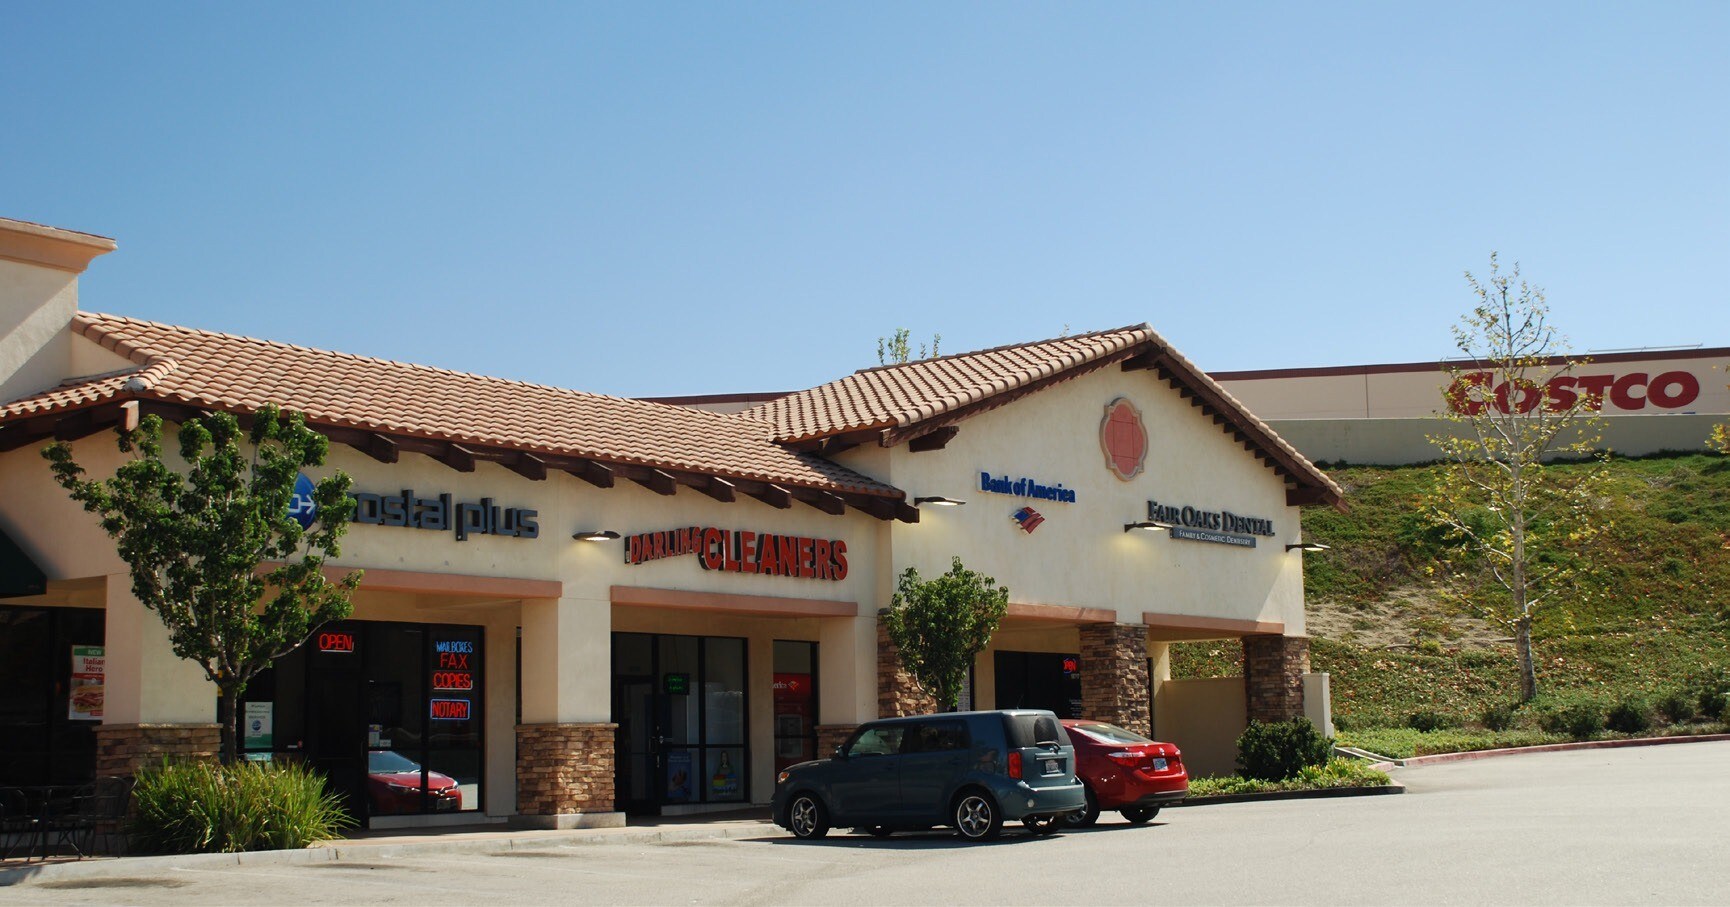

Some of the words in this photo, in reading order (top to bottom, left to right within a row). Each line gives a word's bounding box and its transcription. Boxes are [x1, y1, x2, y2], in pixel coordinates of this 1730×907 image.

[1447, 371, 1700, 415] COSTCO
[979, 472, 1012, 494] Bank
[1013, 478, 1026, 496] of
[1027, 479, 1075, 502] America
[343, 489, 452, 531] ostal
[456, 497, 540, 541] plus
[625, 526, 701, 565] DARLING
[698, 527, 848, 580] CLEANERS
[319, 633, 353, 651] OPEN
[436, 641, 473, 653] MAILBOXES
[85, 665, 103, 673] Hero
[440, 653, 468, 669] FAX
[433, 672, 471, 688] COPIES
[432, 701, 467, 718] NOTARY
